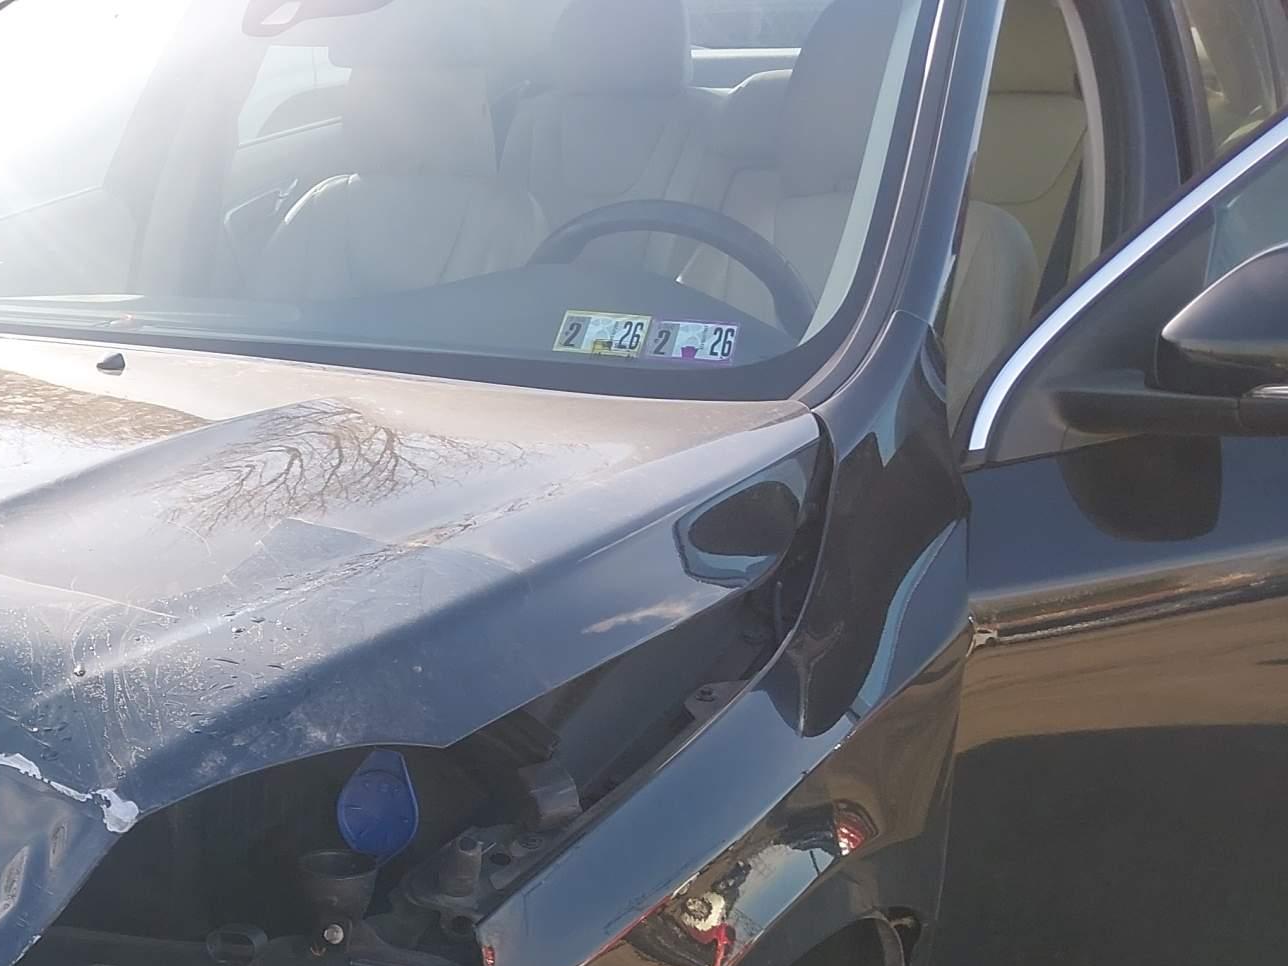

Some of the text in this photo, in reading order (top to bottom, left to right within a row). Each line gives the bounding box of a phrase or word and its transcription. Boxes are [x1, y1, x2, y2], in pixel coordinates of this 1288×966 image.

[563, 322, 582, 347] 2
[617, 321, 645, 350] 26
[653, 329, 671, 355] 2
[710, 327, 735, 357] 26
